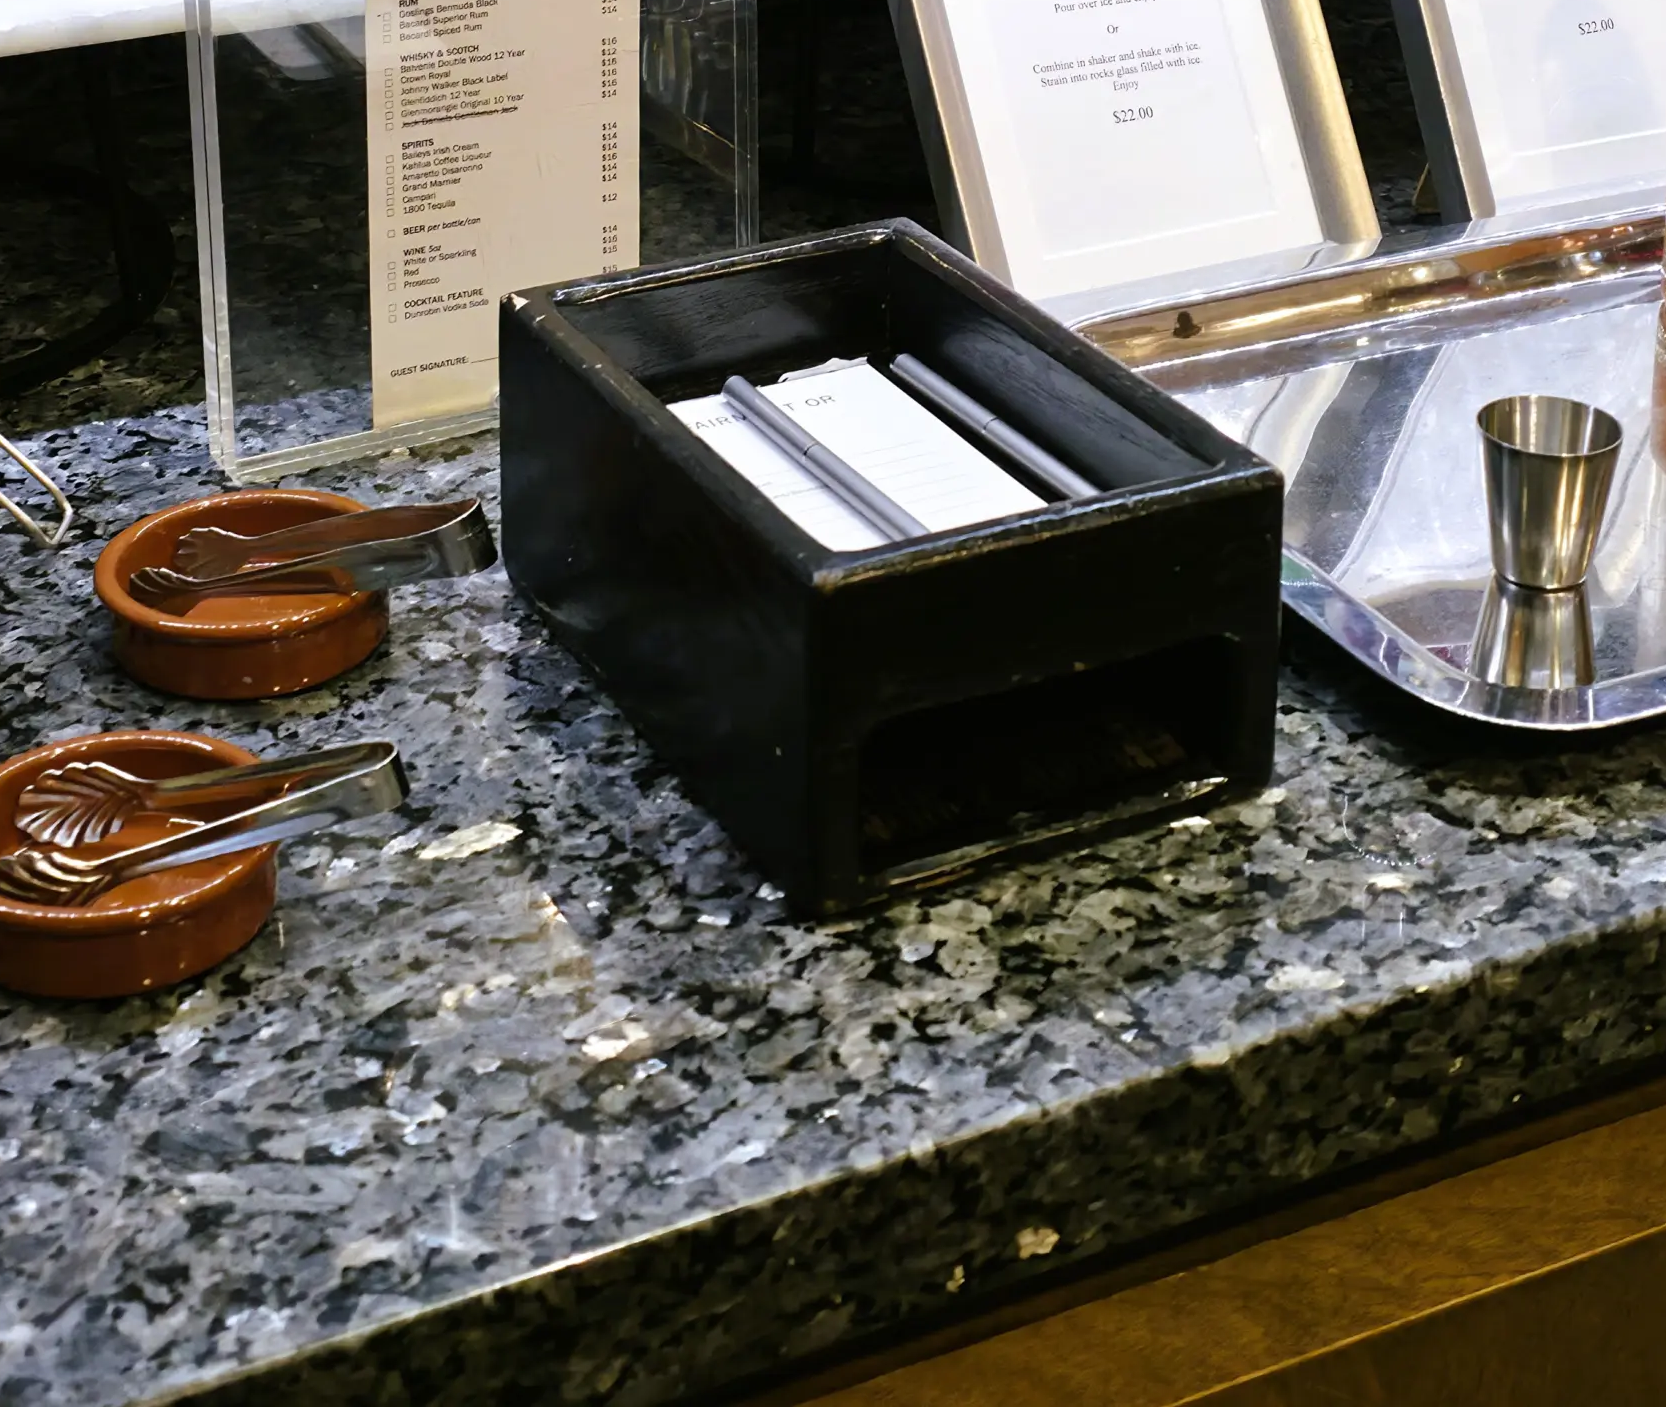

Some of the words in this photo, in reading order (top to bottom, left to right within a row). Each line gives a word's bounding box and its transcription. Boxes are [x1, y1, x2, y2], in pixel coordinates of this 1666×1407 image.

[1054, 1, 1076, 13] Pour
[1107, 24, 1119, 34] Or
[1578, 18, 1614, 35] $22.00
[400, 51, 435, 63] WHISKY
[446, 44, 480, 57] SCOTCH
[1032, 60, 1074, 75] Combine
[1088, 54, 1116, 67] shaker
[1113, 78, 1139, 92] Enjoy
[1112, 106, 1154, 124] $22.00
[401, 138, 434, 150] SPIRITS
[403, 204, 426, 214] 1800
[427, 199, 456, 212] Tequila
[403, 225, 426, 236] BEER
[403, 246, 426, 257] WINE
[404, 294, 445, 309] COCKTAIL
[446, 287, 483, 302] FEATURE
[390, 365, 417, 378] GUEST
[419, 356, 469, 373] SIGNATURE:
